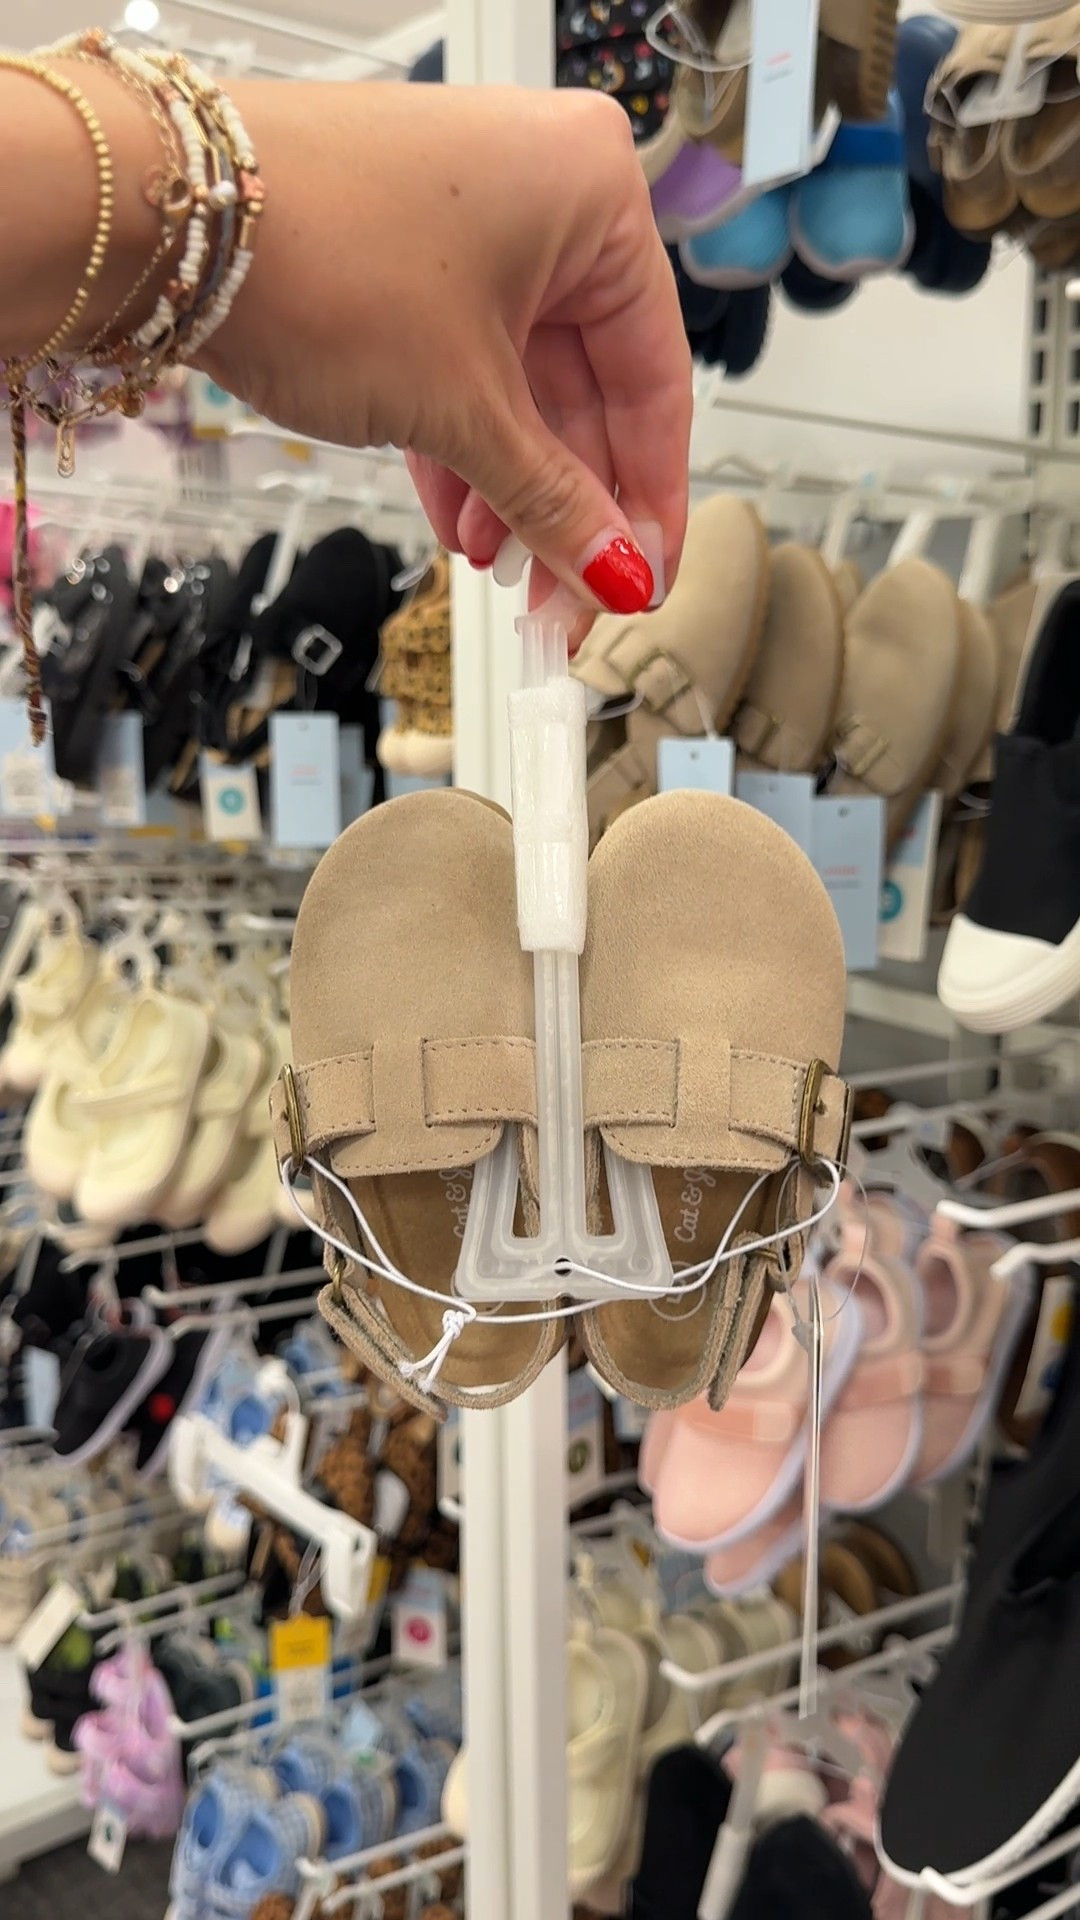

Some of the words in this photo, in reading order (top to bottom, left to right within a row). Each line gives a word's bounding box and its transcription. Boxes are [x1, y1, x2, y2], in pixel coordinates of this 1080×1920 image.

[684, 1167, 717, 1187] J
[445, 1182, 467, 1202] &
[681, 1184, 704, 1205] &
[675, 1208, 700, 1243] Cat
